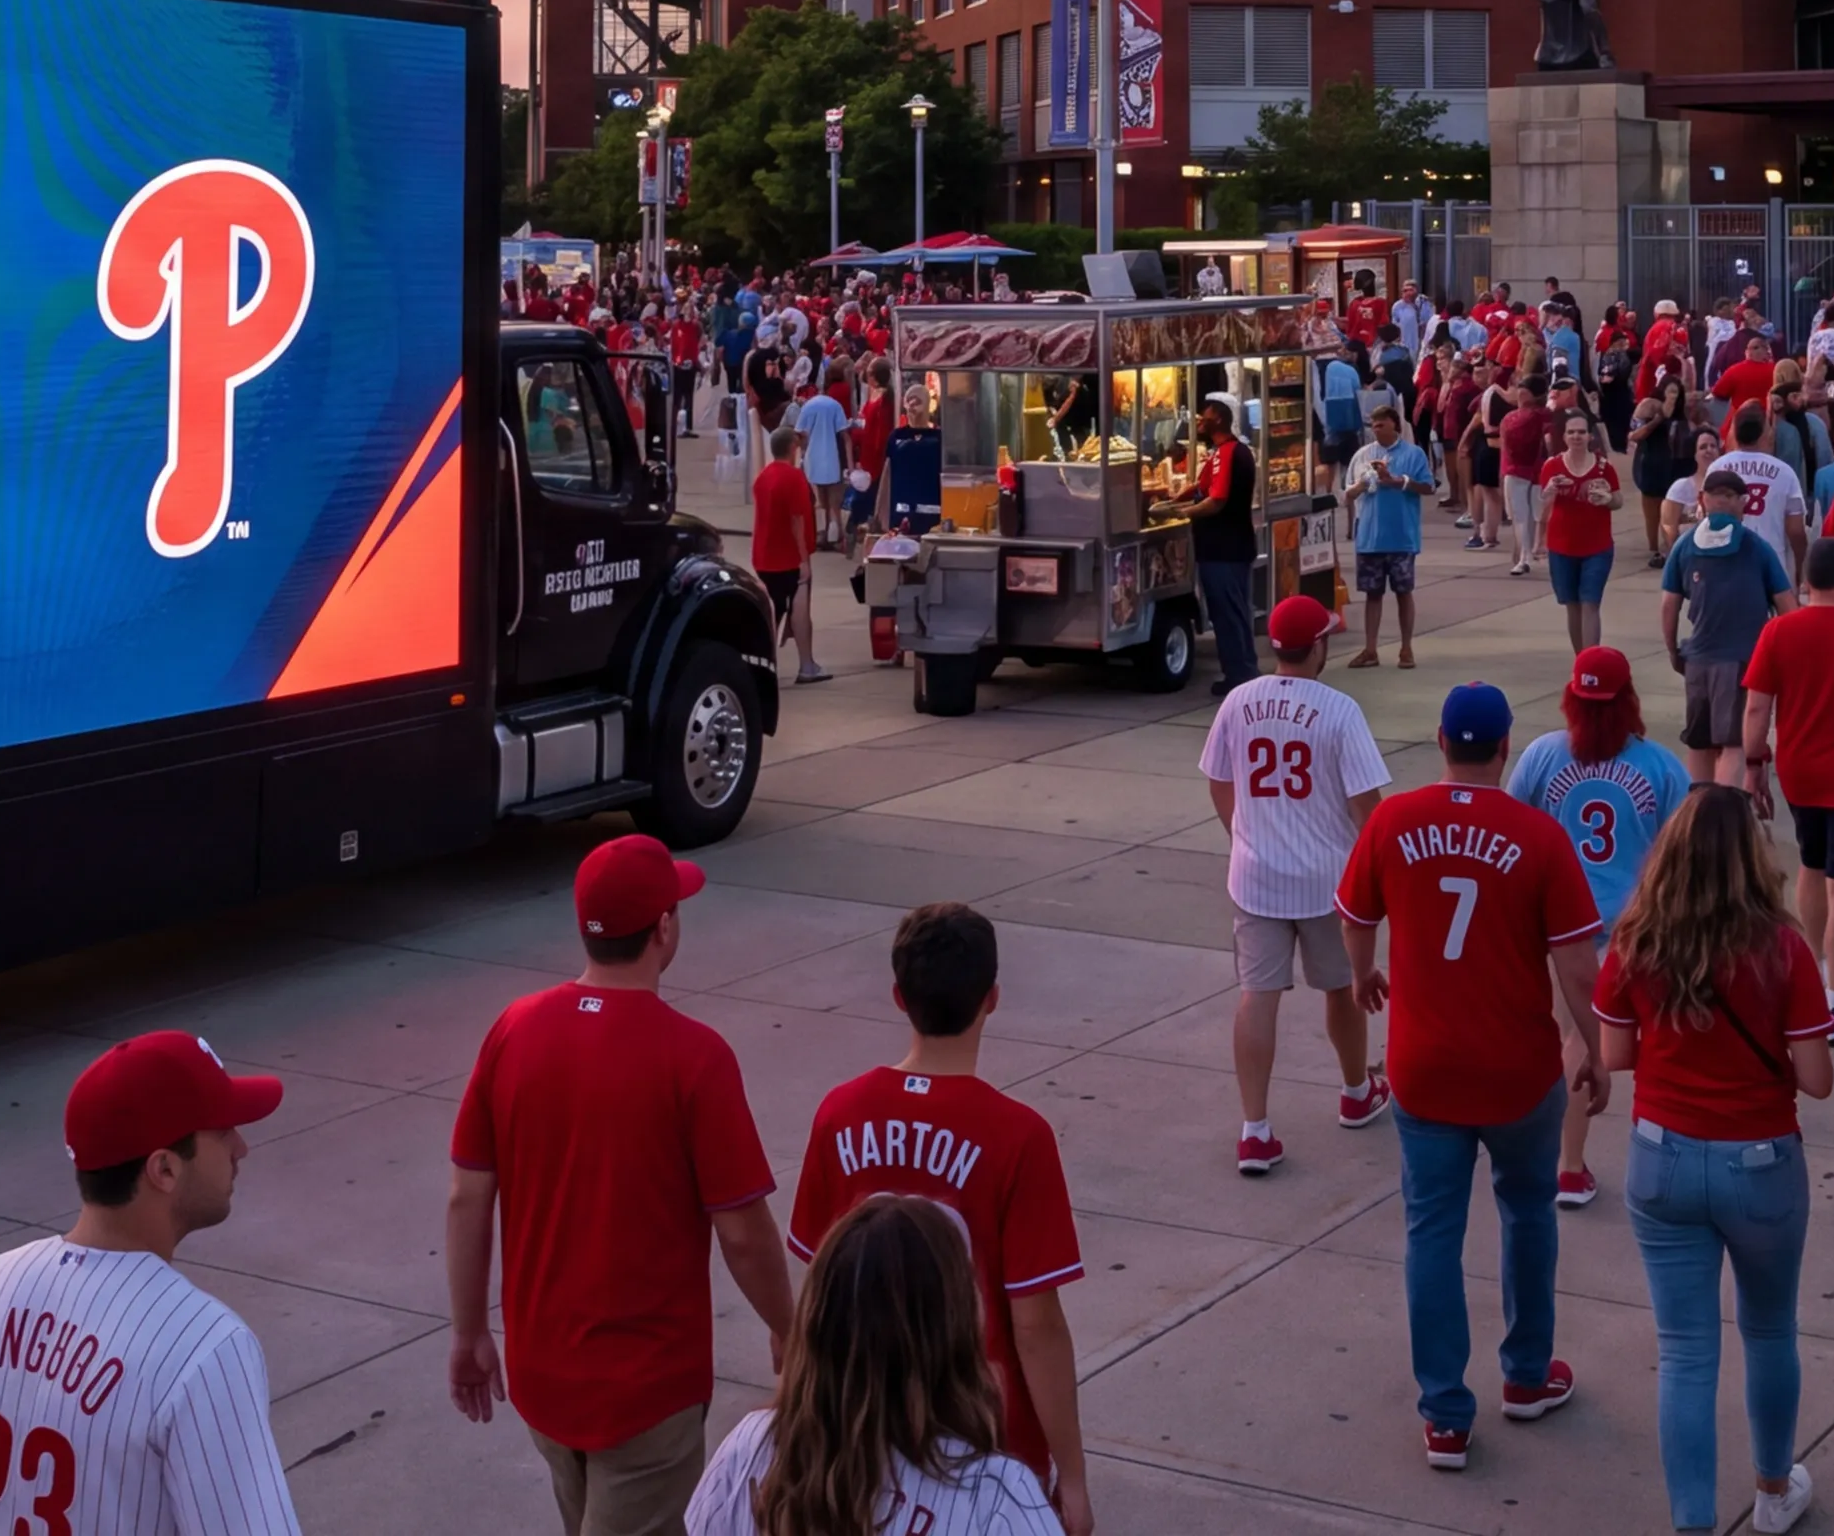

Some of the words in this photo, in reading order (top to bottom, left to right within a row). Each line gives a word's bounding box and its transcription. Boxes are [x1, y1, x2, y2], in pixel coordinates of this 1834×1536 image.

[96, 158, 315, 559] P
[1248, 737, 1313, 800] 23
[1579, 799, 1617, 865] 3
[1439, 876, 1478, 960] 7
[836, 1119, 982, 1190] HARTON
